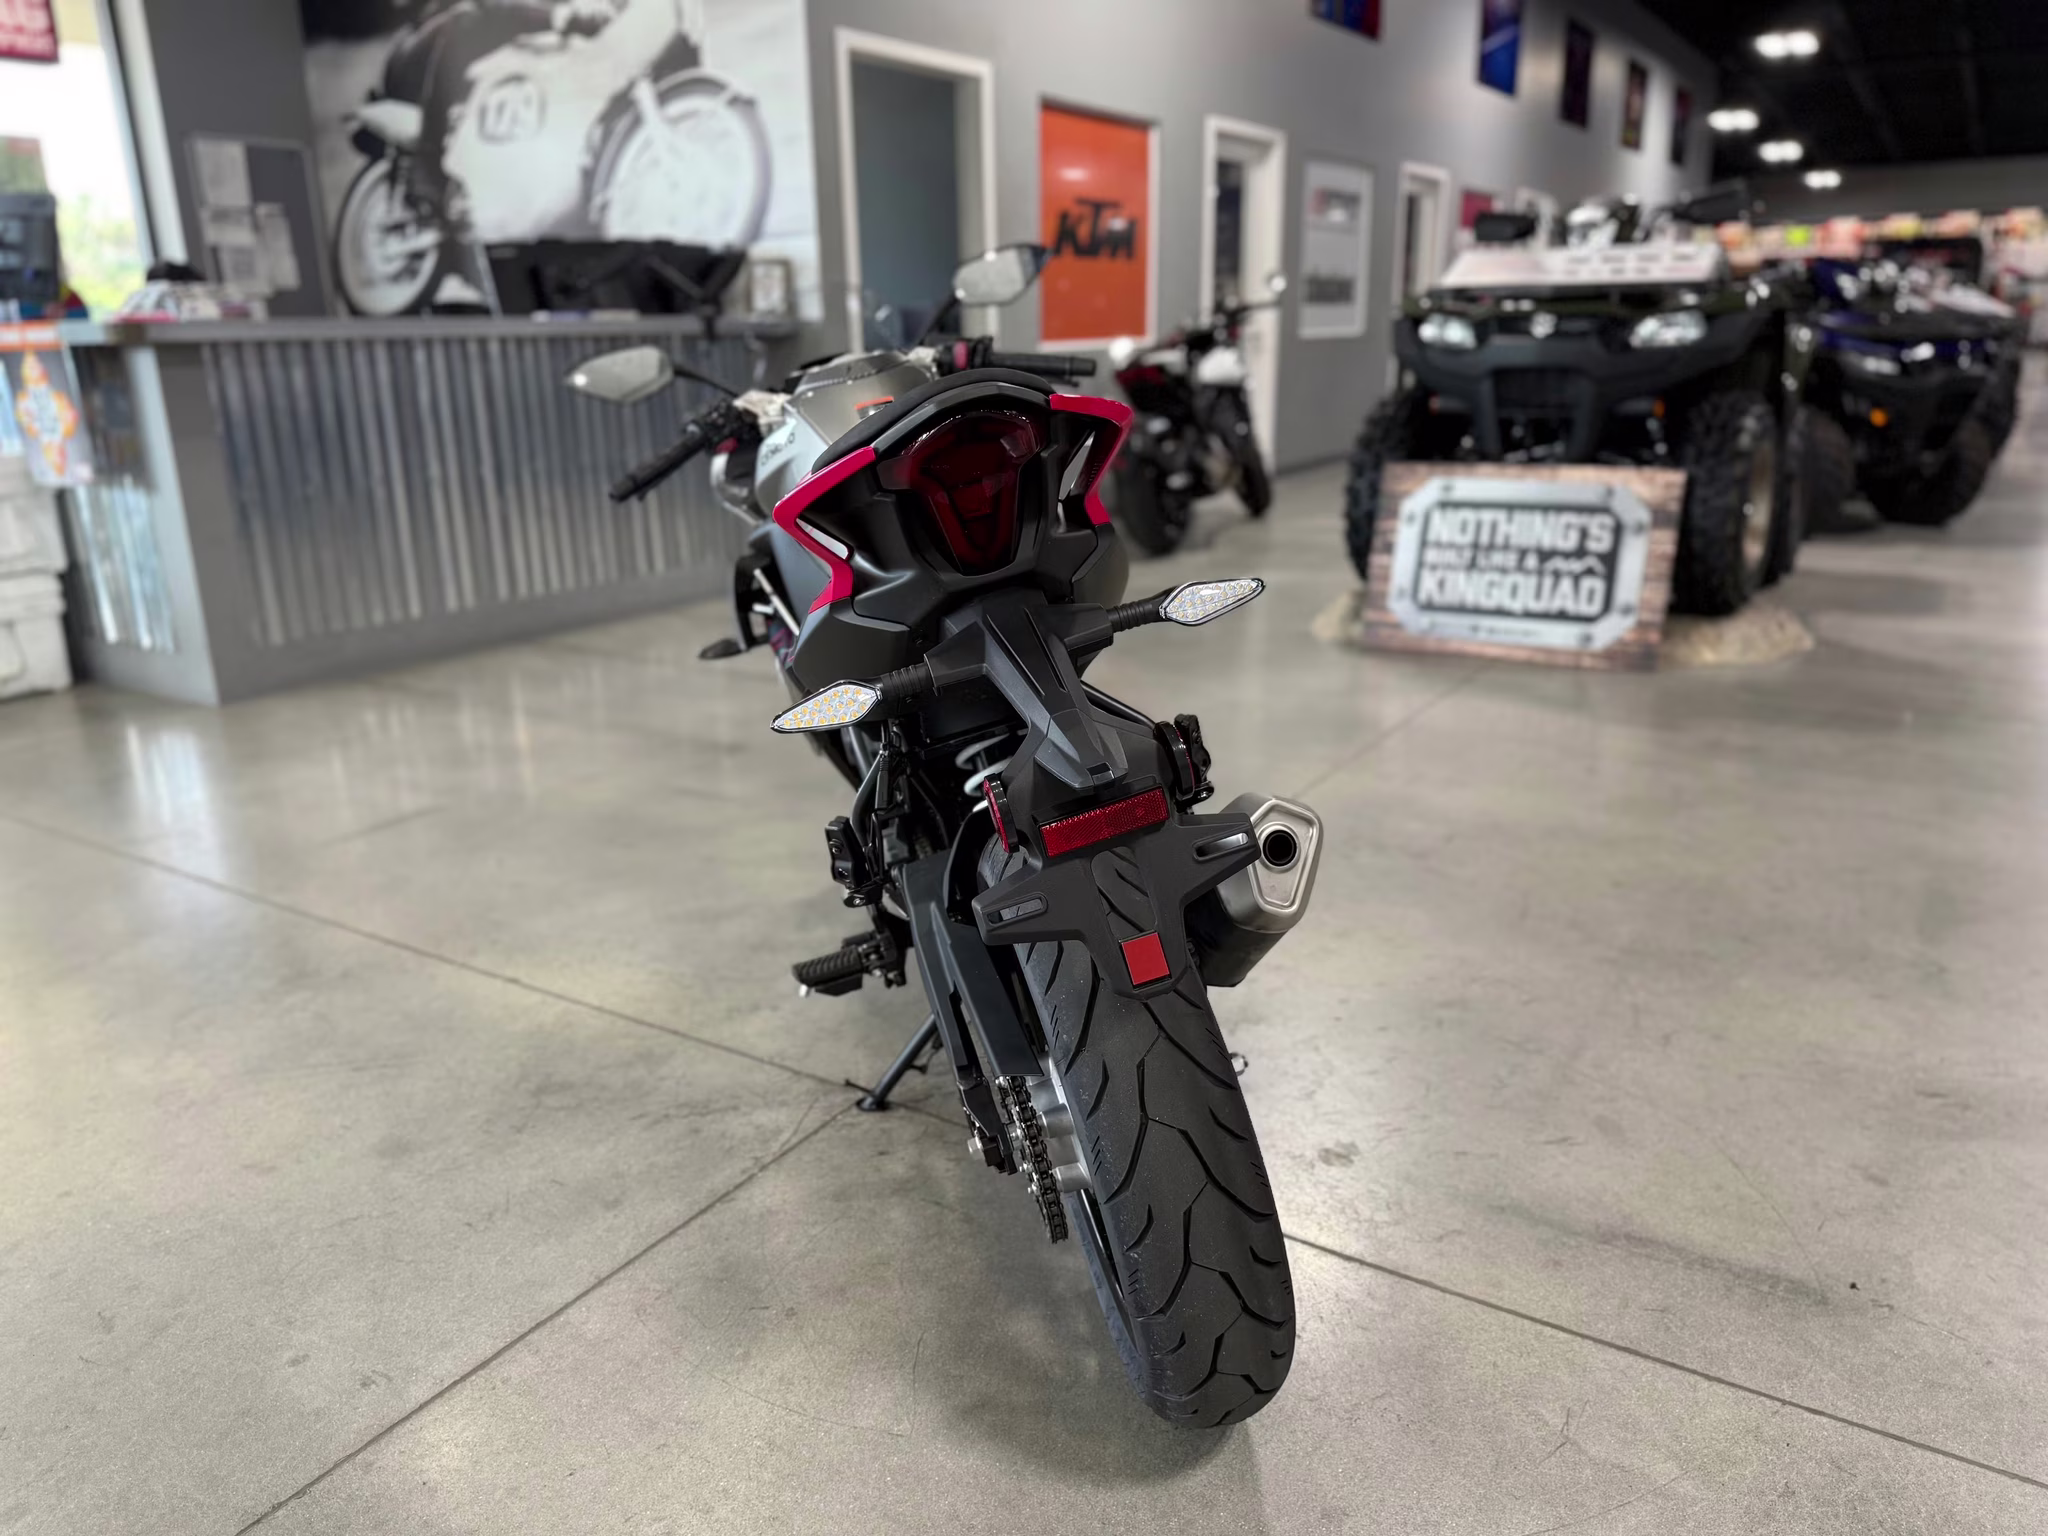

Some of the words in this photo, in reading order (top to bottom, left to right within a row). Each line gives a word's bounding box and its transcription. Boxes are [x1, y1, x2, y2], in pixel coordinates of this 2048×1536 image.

[1054, 197, 1138, 260] KTM
[1426, 507, 1615, 554] NOTHING'S
[1416, 569, 1606, 617] KINGQUAD
